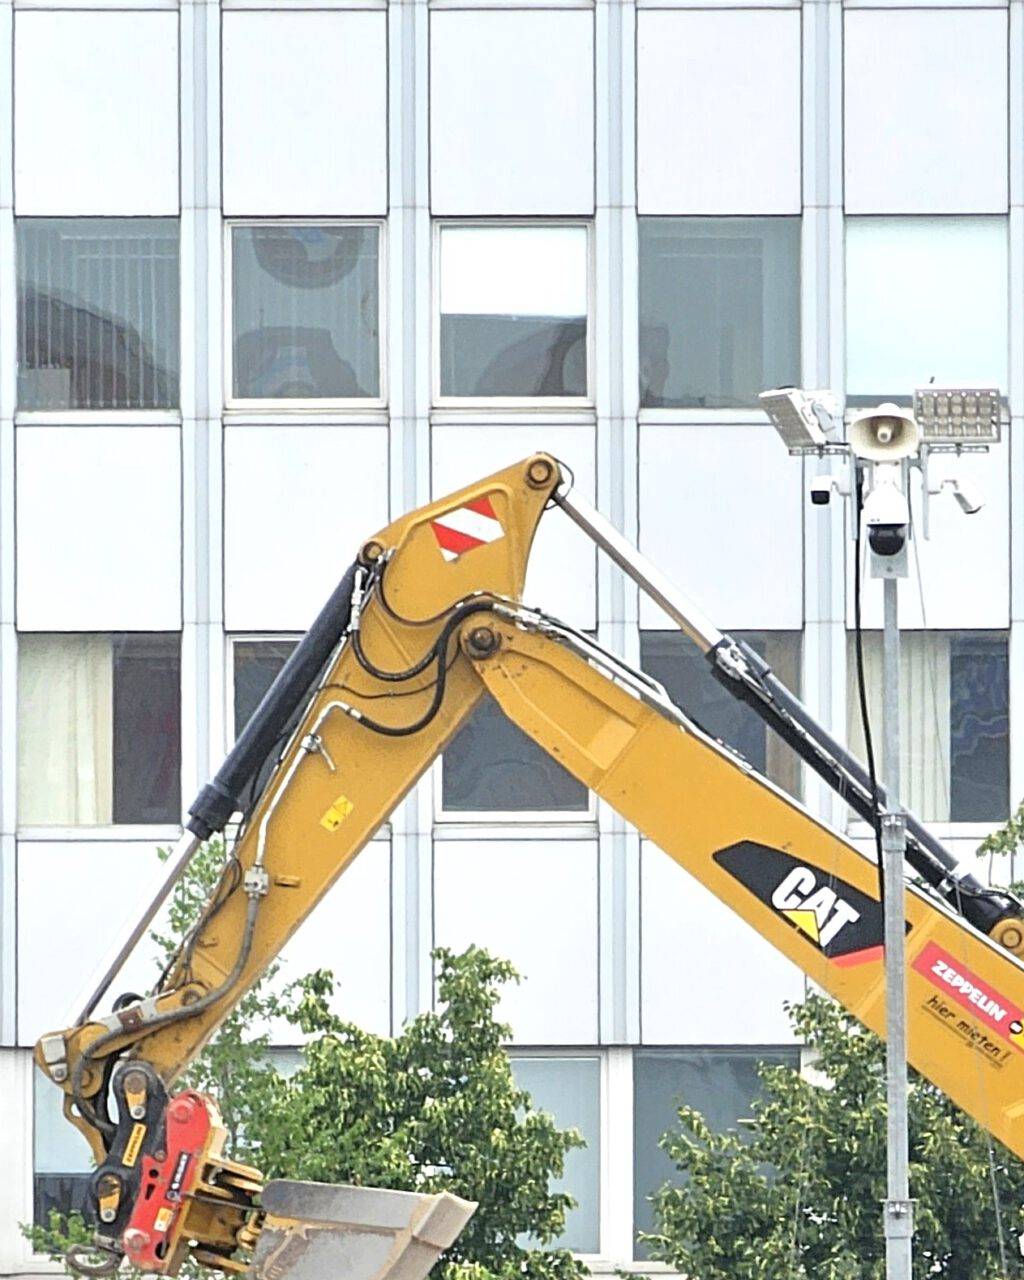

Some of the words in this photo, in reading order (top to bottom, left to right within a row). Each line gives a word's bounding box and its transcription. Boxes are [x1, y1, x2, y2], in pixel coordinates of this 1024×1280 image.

[772, 866, 860, 947] CAT
[926, 995, 956, 1019] hier
[931, 960, 1008, 1023] ZEPPELIN
